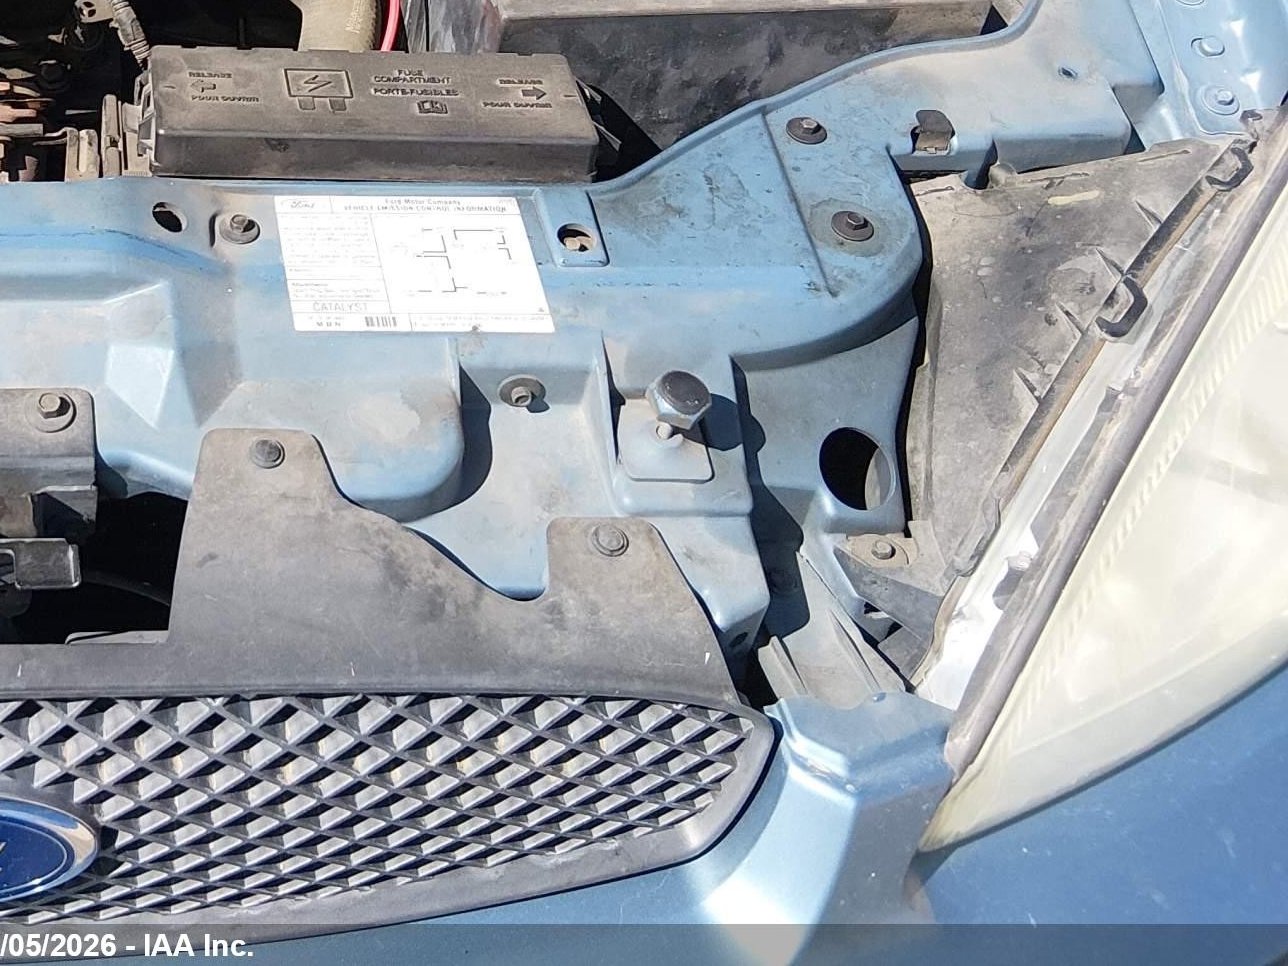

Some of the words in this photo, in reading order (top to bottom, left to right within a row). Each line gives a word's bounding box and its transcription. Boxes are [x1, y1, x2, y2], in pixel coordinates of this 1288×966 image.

[397, 69, 424, 77] FUSE
[373, 75, 451, 84] COMPARTMENT
[313, 301, 369, 312] CATALYST
